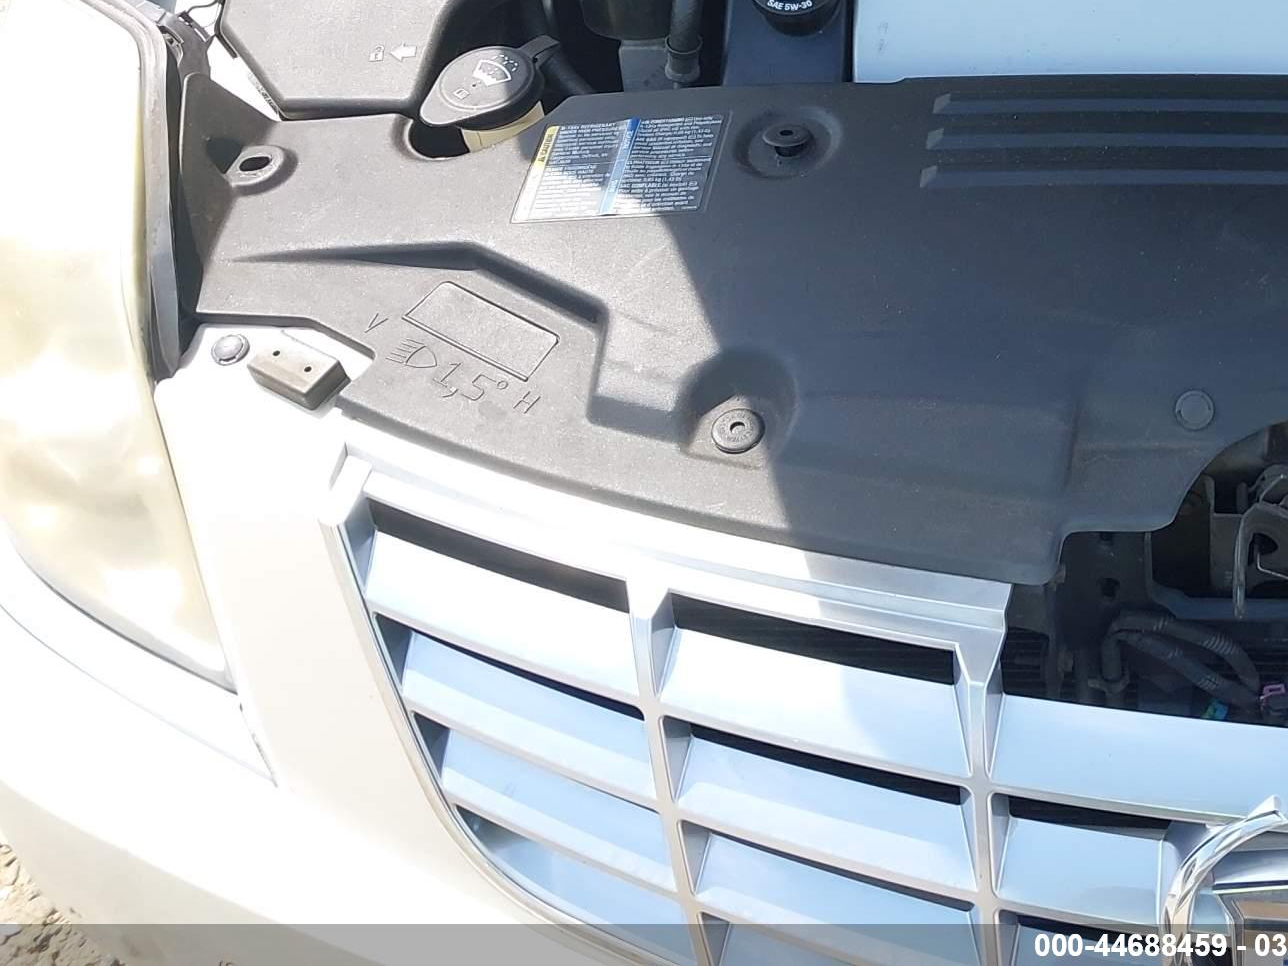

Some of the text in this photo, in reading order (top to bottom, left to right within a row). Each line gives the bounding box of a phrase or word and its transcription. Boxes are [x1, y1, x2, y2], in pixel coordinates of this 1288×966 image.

[767, 0, 813, 12] SAE 5W-30
[512, 390, 542, 415] H
